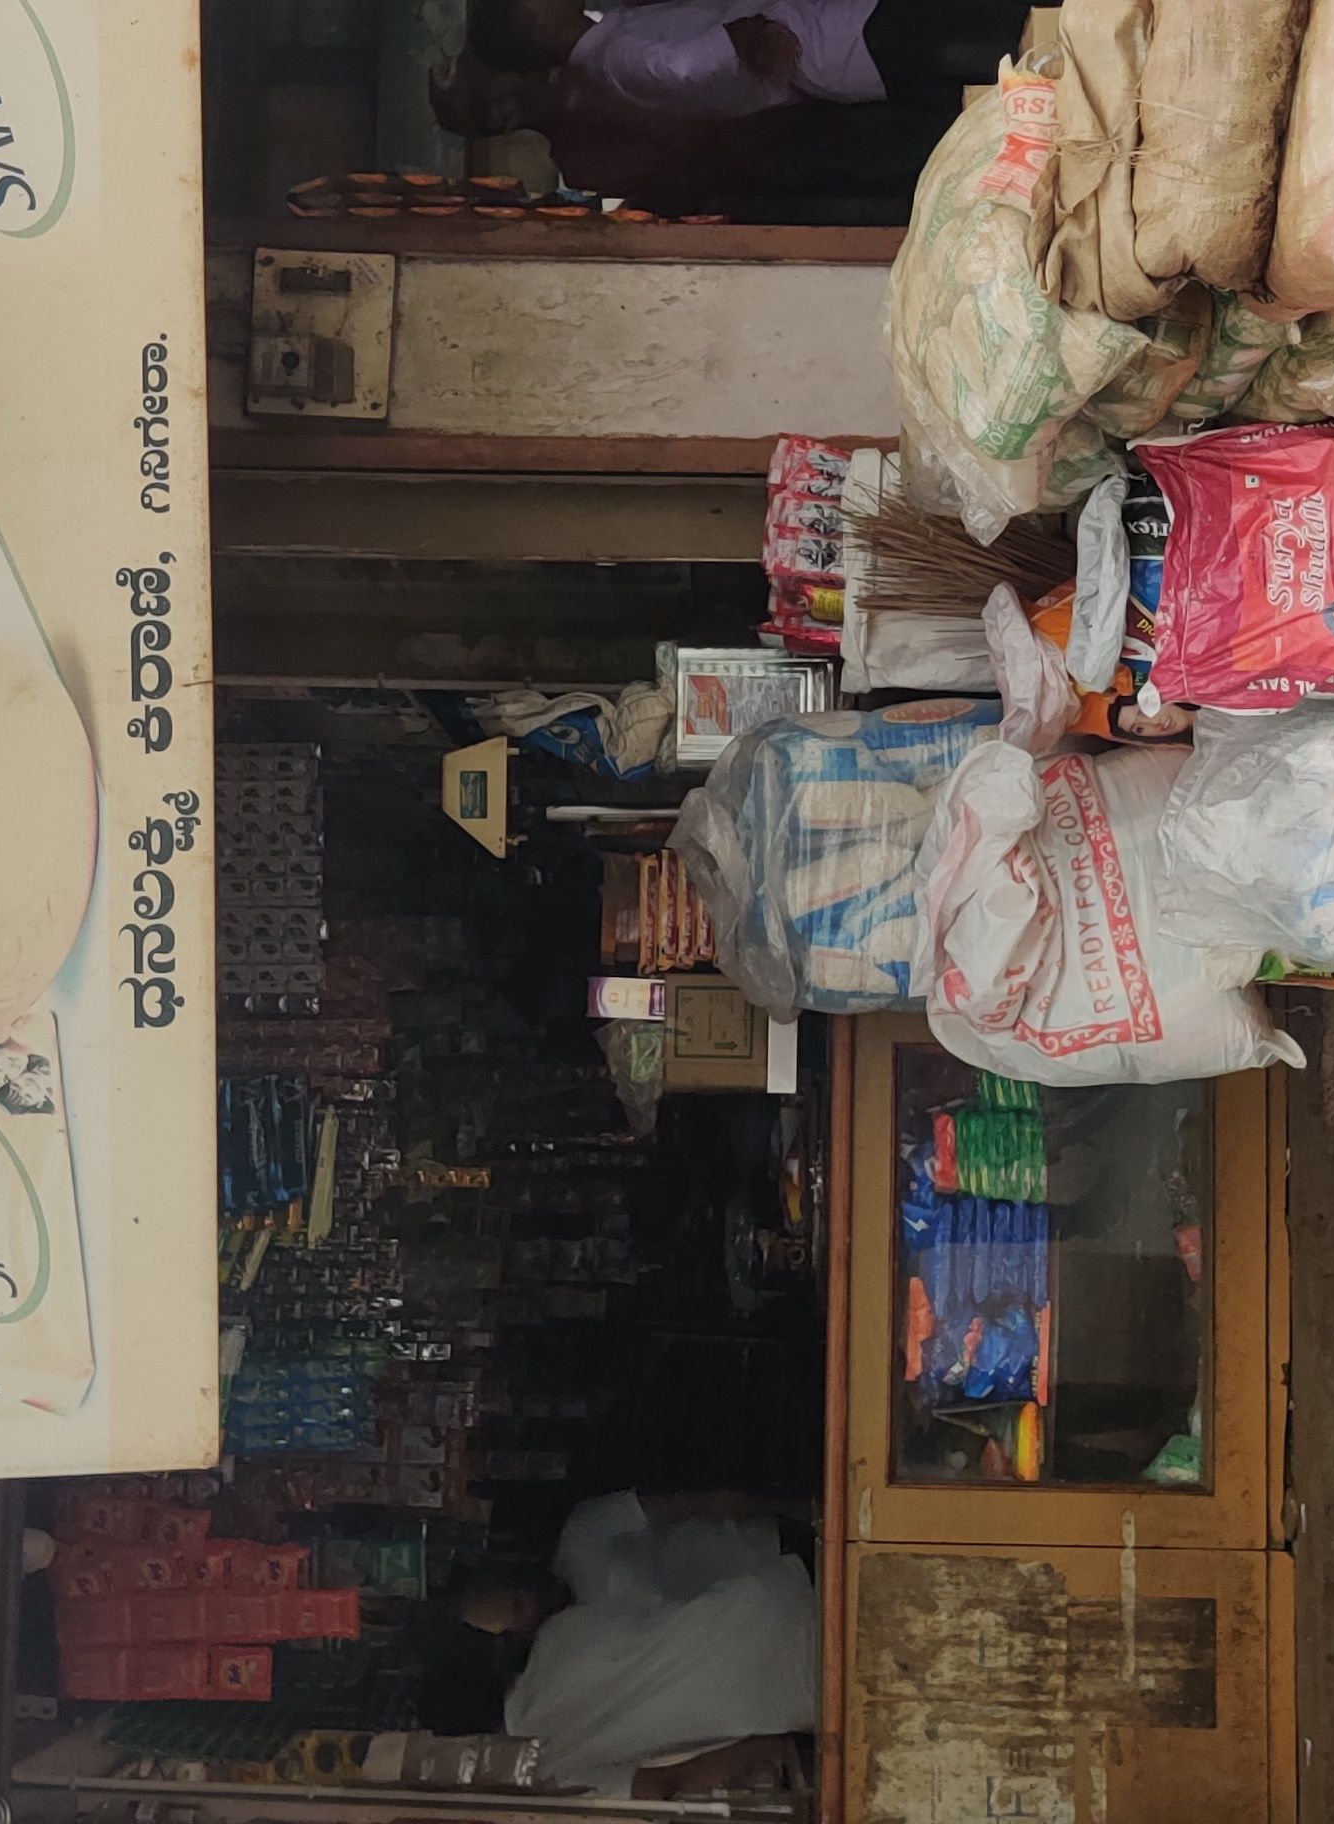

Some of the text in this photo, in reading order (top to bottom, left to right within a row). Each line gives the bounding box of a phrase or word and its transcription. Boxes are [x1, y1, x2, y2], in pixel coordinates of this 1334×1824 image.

[1266, 497, 1307, 612] Surya
[1299, 494, 1327, 612] Shuddh
[1246, 677, 1290, 693] SALT
[1044, 785, 1086, 846] COOK
[1070, 853, 1097, 910] FOR
[1077, 919, 1116, 1013] READY
